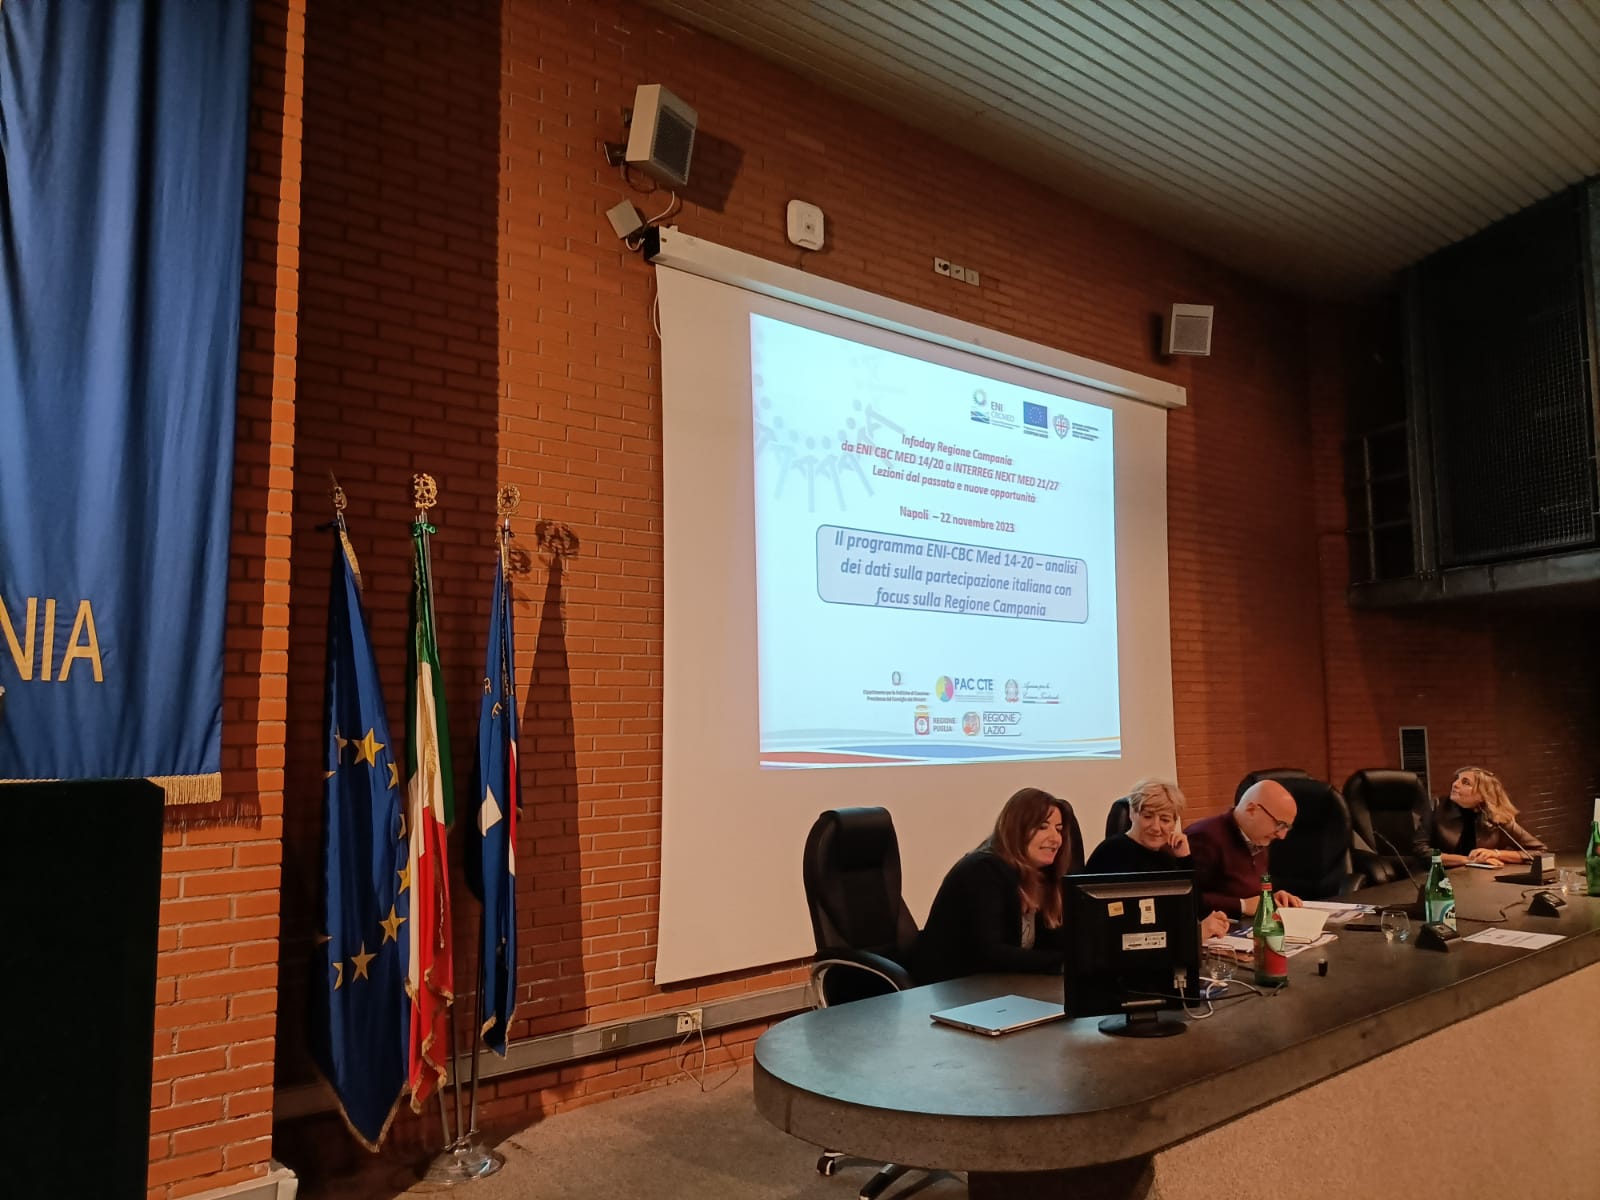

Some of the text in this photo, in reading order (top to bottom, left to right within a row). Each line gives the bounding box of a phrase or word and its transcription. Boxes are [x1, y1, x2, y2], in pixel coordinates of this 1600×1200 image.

[991, 401, 1003, 412] ENI
[902, 433, 1012, 466] Infoday Regione Campania
[841, 440, 1060, 491] da ENI CBC MED 14/20 a INTERREG NEXT MED 21/27
[873, 465, 904, 480] Lezioni
[906, 471, 920, 483] dal
[957, 482, 962, 490] e
[964, 484, 988, 495] nuove
[990, 488, 1036, 503] opportunità
[900, 505, 929, 520] Napoli
[940, 512, 951, 523] 22
[953, 516, 994, 530] novembre
[996, 521, 1015, 532] 2023
[835, 530, 844, 546] Il
[846, 535, 923, 556] programma
[926, 543, 974, 561] ENI-CBC
[976, 550, 1001, 565] Med
[1004, 553, 1034, 569] 14-20
[1045, 560, 1078, 574] analisi
[841, 557, 1071, 596] dei dati sulla partecipazione italiana con
[875, 587, 1046, 617] focus sulla Regione Campania
[954, 678, 993, 691] PAC CTE
[933, 717, 956, 725] REGIONE
[983, 713, 1016, 722] REGIONE
[983, 726, 1006, 734] LAZIO
